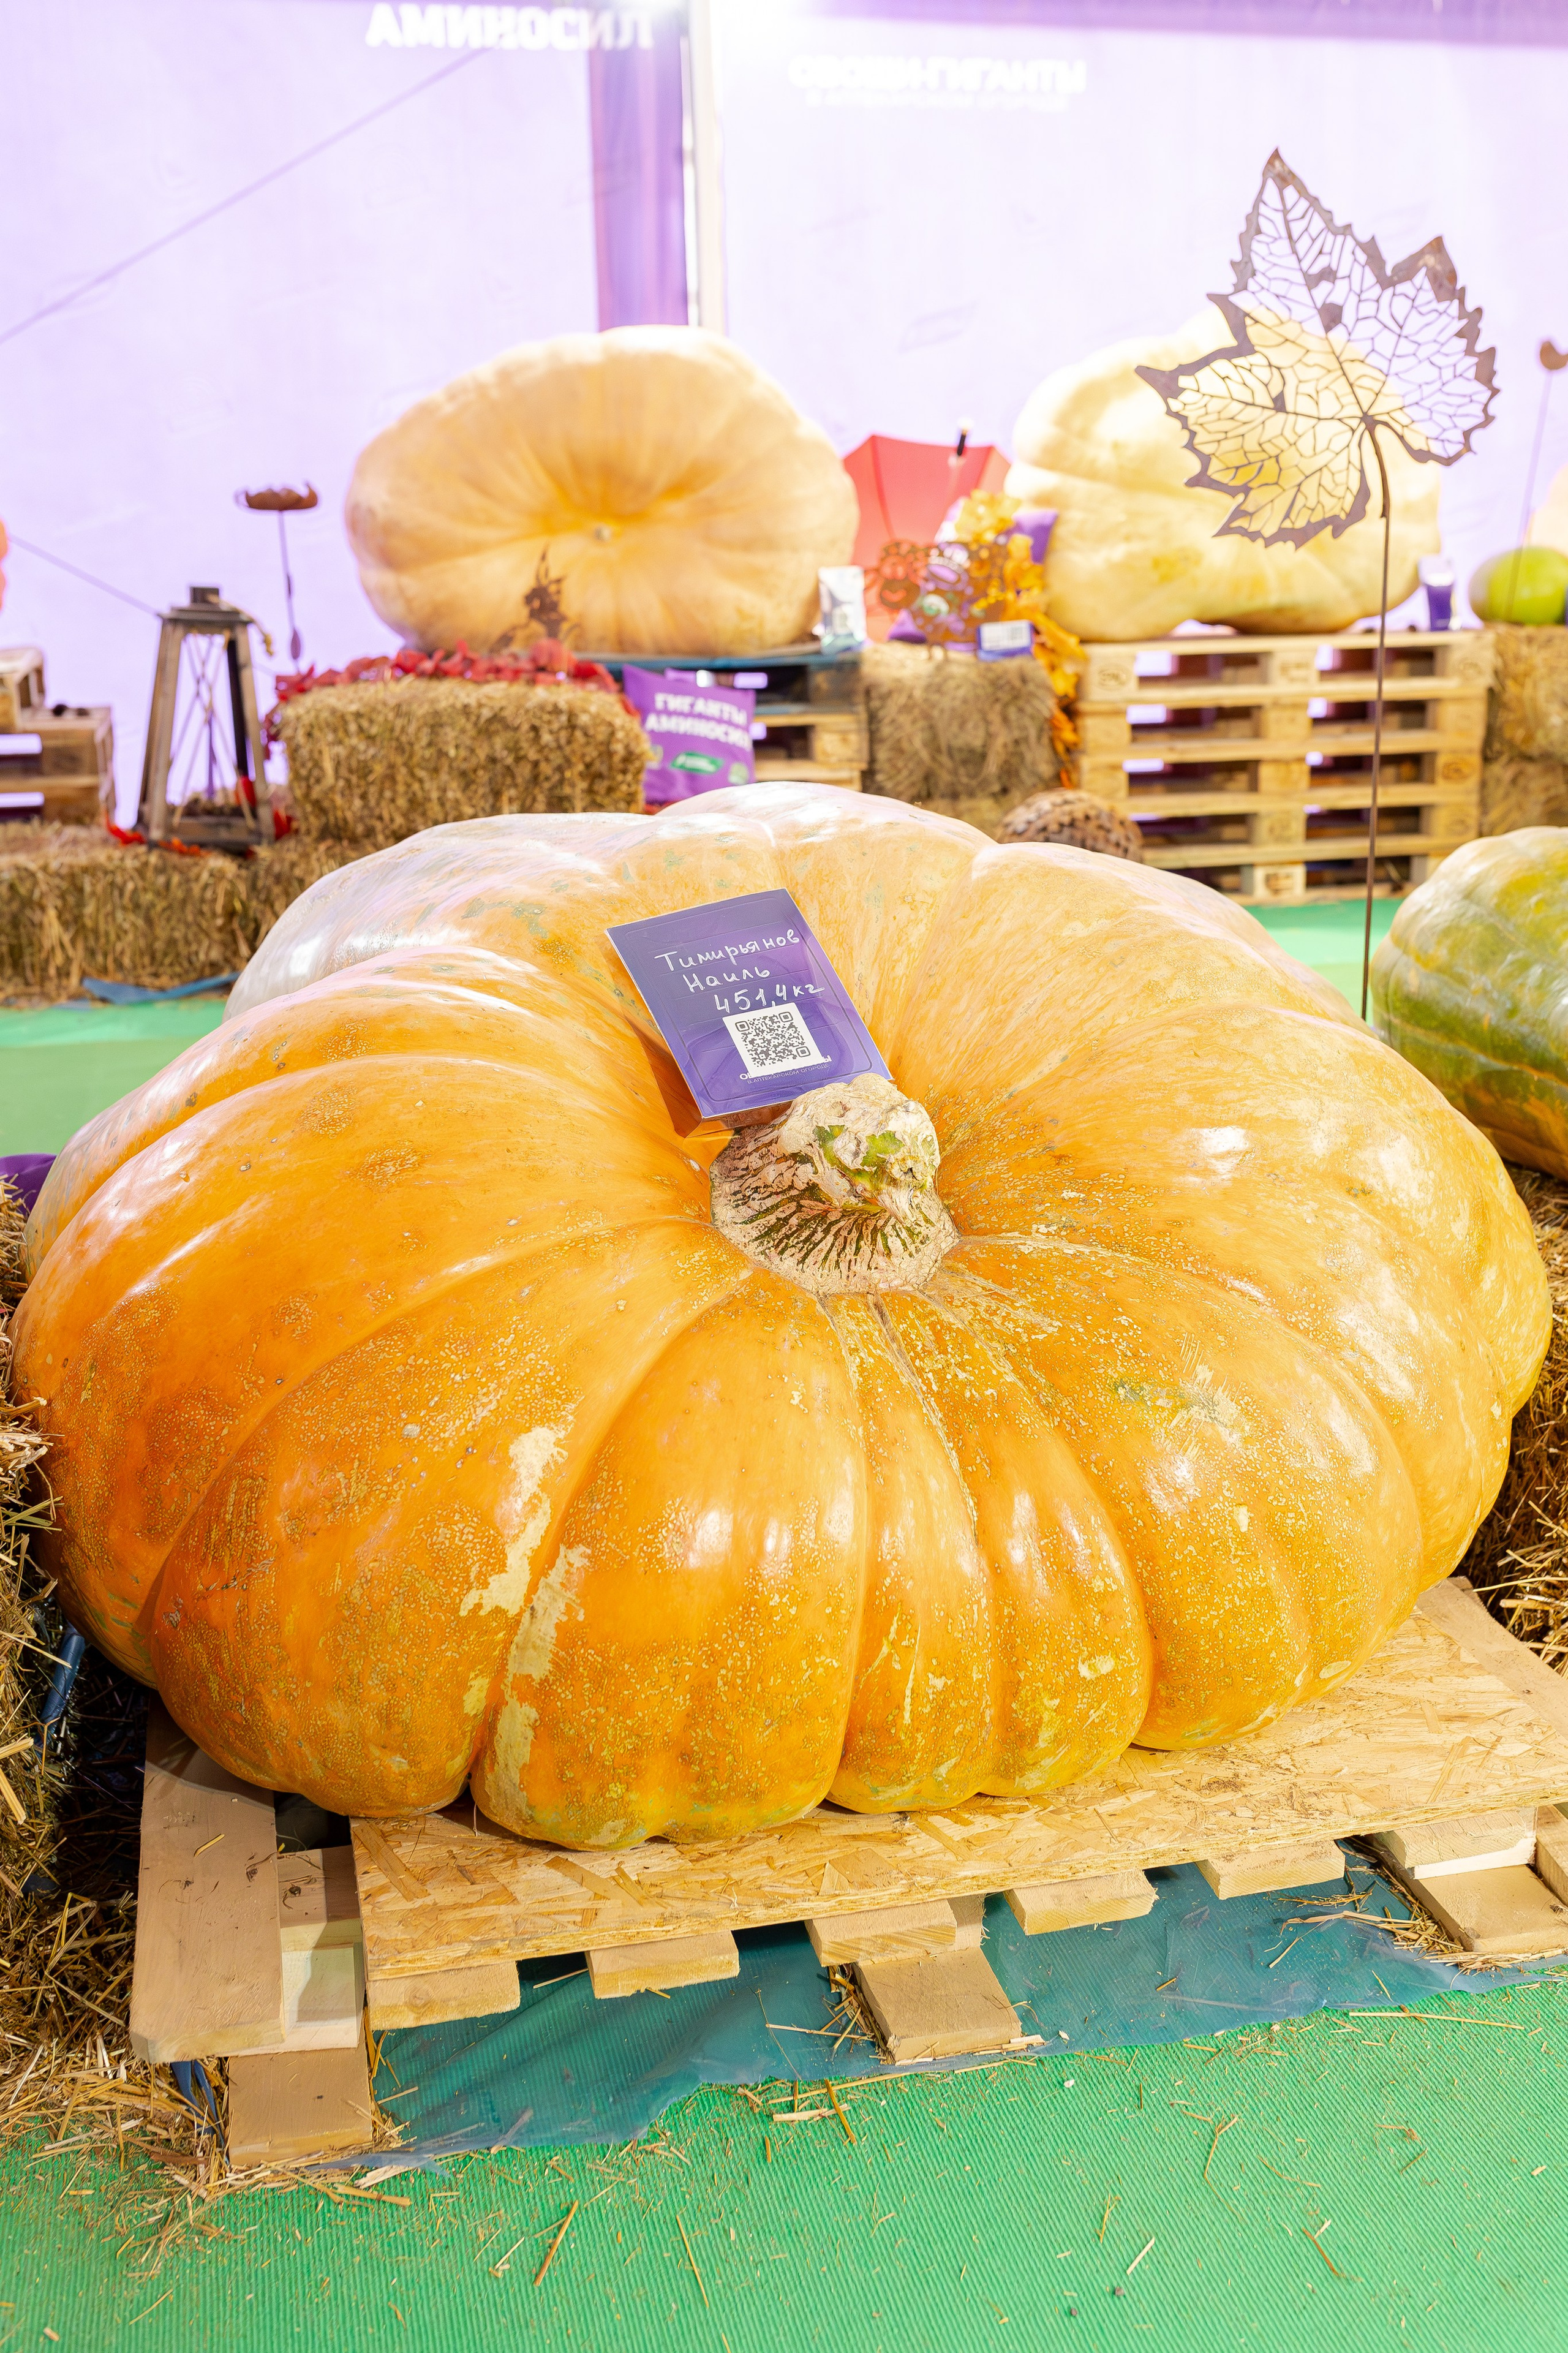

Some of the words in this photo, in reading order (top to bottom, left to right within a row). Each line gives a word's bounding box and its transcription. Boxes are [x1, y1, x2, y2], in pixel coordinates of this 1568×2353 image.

[366, 2, 654, 51] АМИНОСИЛ
[654, 692, 748, 727] ГИГАНТЫ
[682, 966, 771, 993] Наиль
